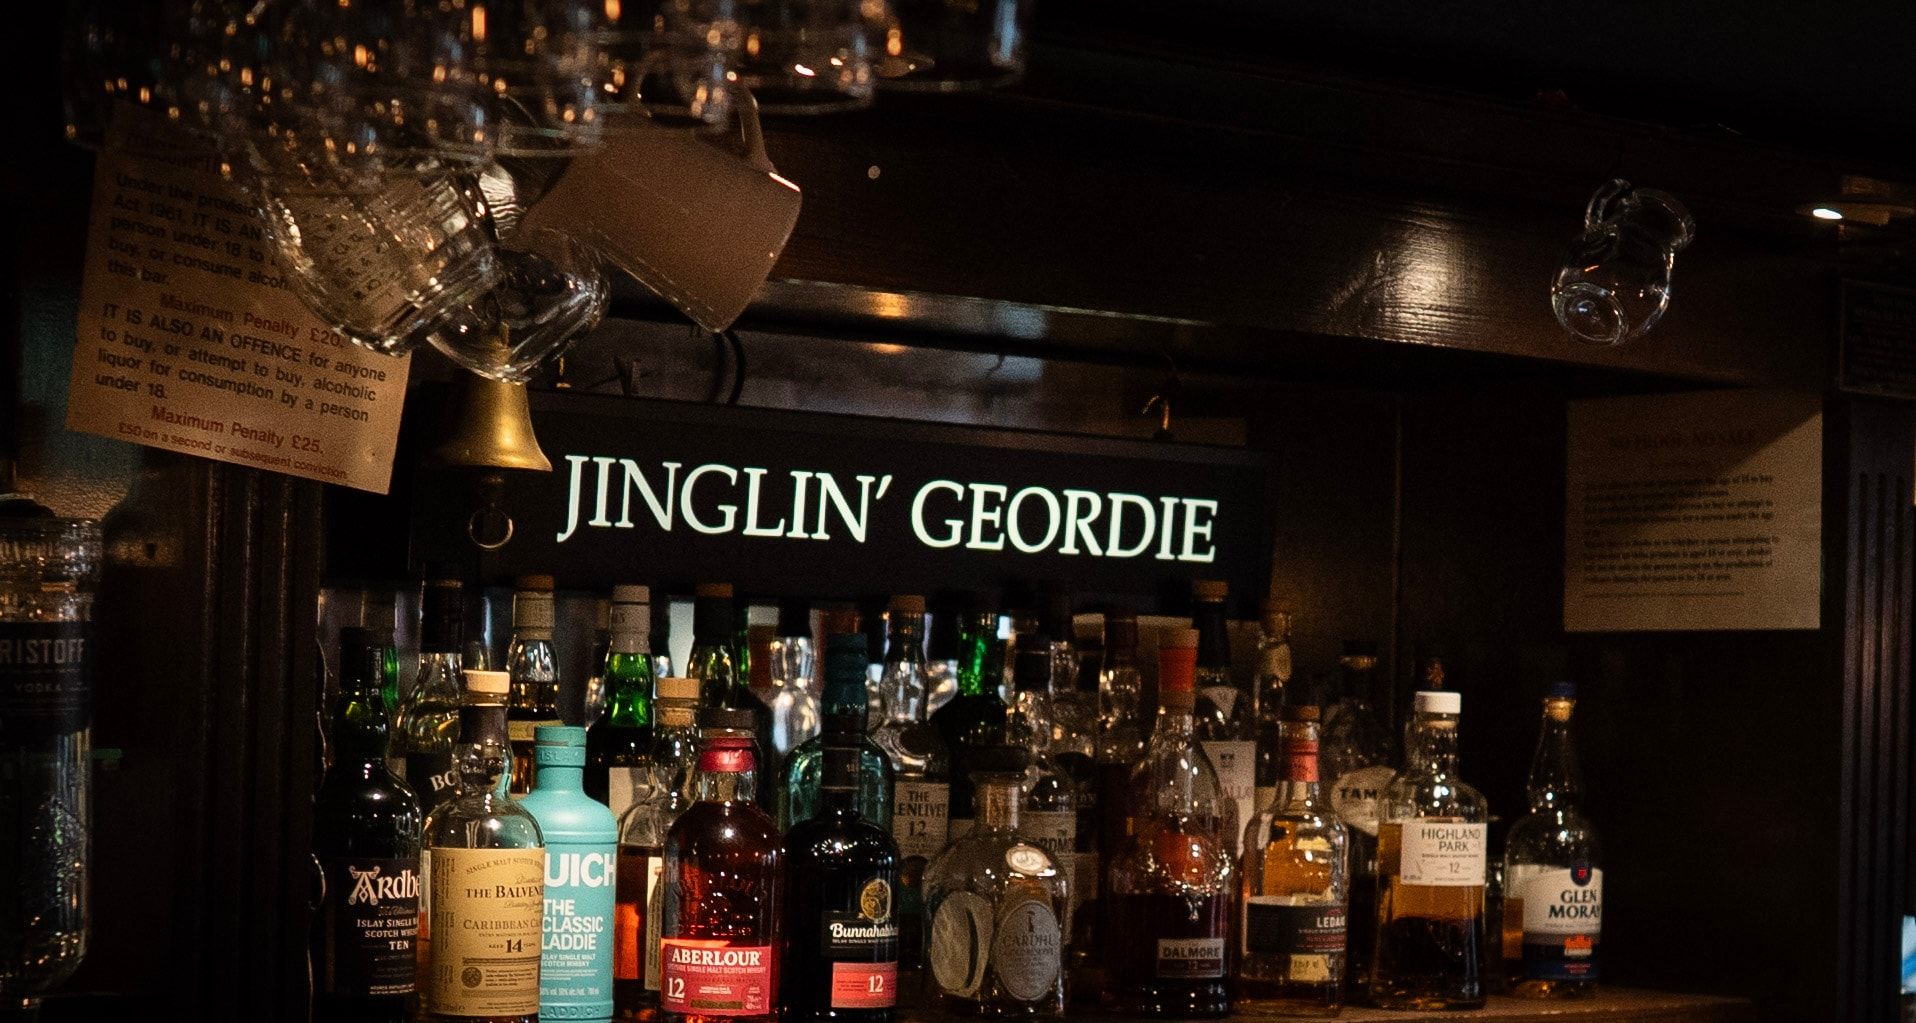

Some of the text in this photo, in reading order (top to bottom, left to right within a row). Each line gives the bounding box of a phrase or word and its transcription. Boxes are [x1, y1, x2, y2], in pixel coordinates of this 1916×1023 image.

[114, 194, 140, 213] Act
[192, 211, 209, 226] IT
[215, 219, 231, 234] IS
[199, 194, 258, 217] provisio
[111, 216, 264, 263] person under 18 to
[108, 259, 136, 278] this
[149, 248, 165, 261] or
[173, 254, 242, 279] consume
[160, 294, 233, 321] Maximum
[244, 312, 300, 339] Penalty
[102, 302, 387, 382] IT IS ALSO AN OFFENCE for anyone
[101, 326, 117, 342] to
[165, 343, 181, 356] or
[188, 348, 247, 372] attempt
[254, 361, 270, 377] to
[313, 377, 377, 402] alcoholic
[95, 373, 142, 392] under
[98, 347, 369, 422] liquor for consumption by a person
[151, 405, 324, 454] Maximum Penalty £25.
[557, 453, 1219, 563] JINGLIN' GEORDIE
[907, 791, 929, 802] THE
[909, 820, 927, 837] 12
[1421, 828, 1481, 840] HIGHLAND
[1438, 841, 1469, 852] PARK
[1449, 862, 1460, 873] 12
[465, 888, 492, 899] THE
[1560, 889, 1597, 904] GLEN
[542, 899, 575, 916] THE
[357, 918, 384, 928] ISLAY
[463, 919, 529, 931] CARIBBEAN
[541, 916, 603, 933] CLASSIC
[364, 929, 399, 939] SCOTCH
[541, 933, 597, 950] LADDIE
[388, 940, 410, 951] TEN
[505, 939, 523, 953] 14
[1163, 946, 1220, 958] DALMORE
[672, 948, 760, 966] ABERLOUR
[667, 977, 685, 998] 12
[868, 975, 884, 993] 12
